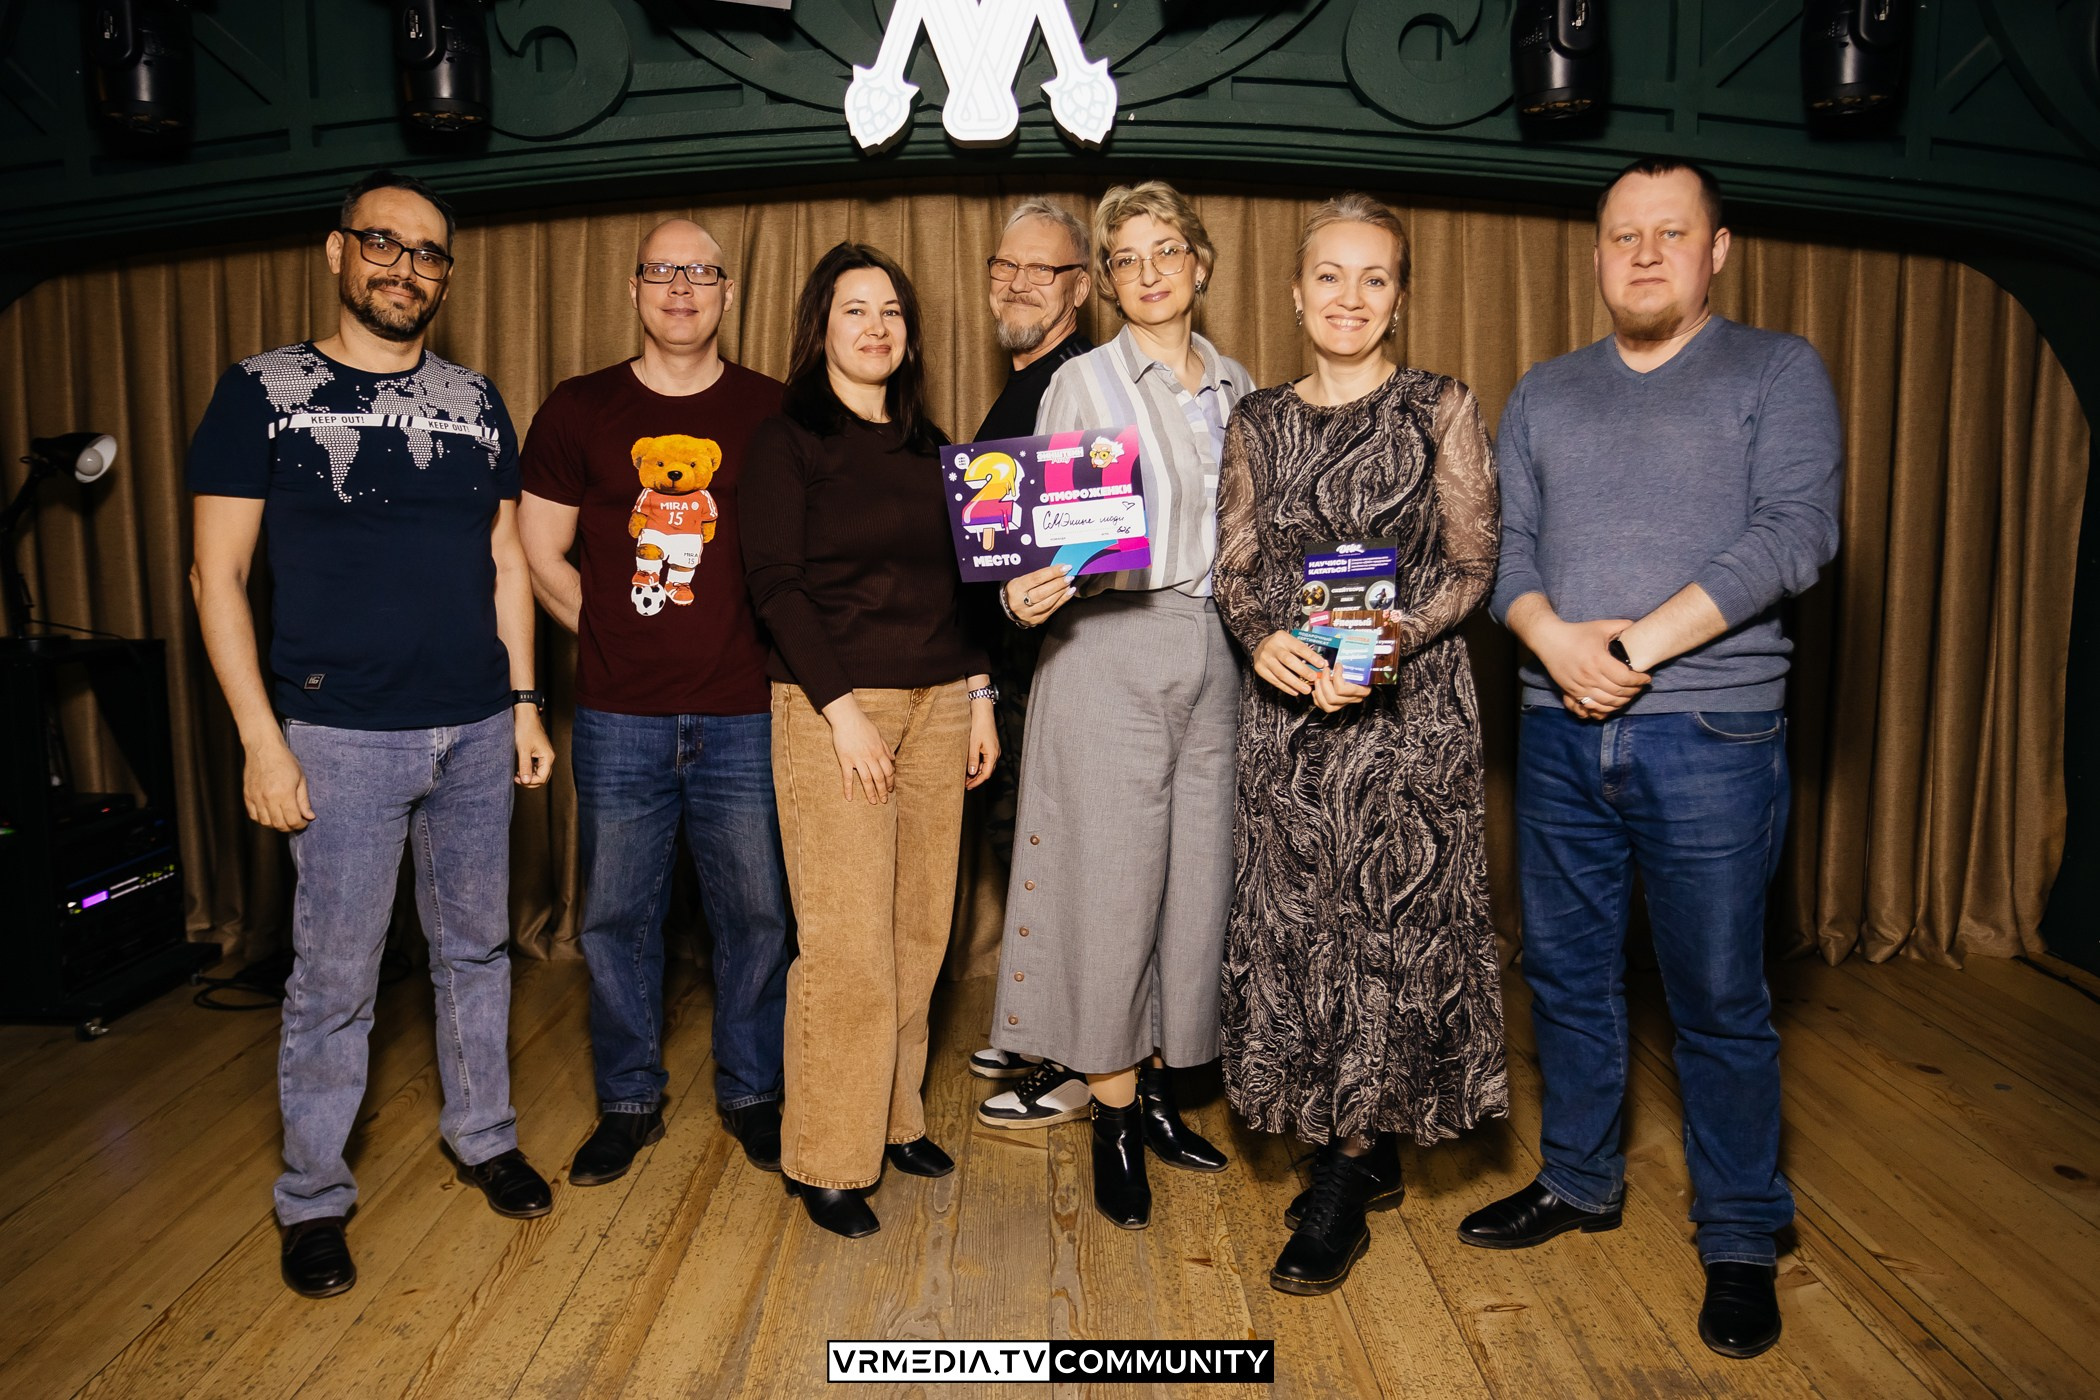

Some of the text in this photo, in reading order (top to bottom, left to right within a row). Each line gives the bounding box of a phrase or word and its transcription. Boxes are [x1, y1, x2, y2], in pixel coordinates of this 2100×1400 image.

[310, 415, 365, 425] KEEP OUT!
[428, 420, 470, 433] KEEP OUT!
[962, 451, 1025, 532] 2
[1039, 483, 1133, 503] ОТМОРОЖЕНКИ
[660, 501, 688, 511] MIRA
[668, 511, 684, 526] 15
[972, 553, 1022, 568] МЕСТО
[1308, 558, 1347, 568] НАУЧИСЬ
